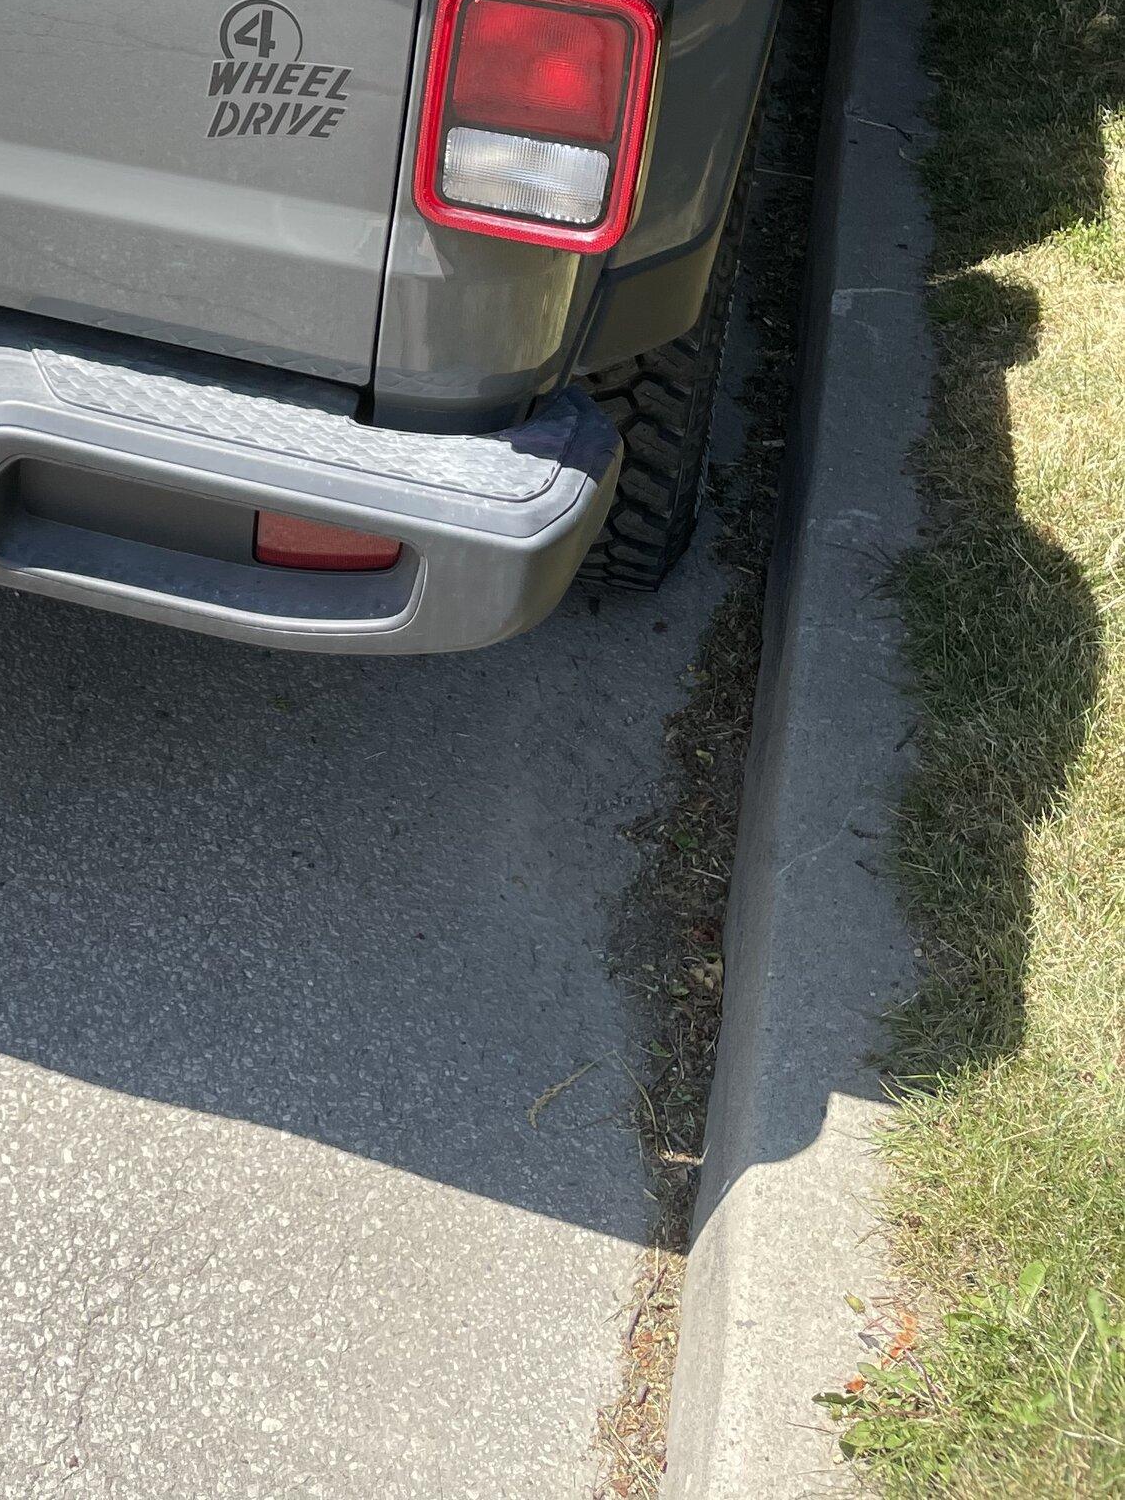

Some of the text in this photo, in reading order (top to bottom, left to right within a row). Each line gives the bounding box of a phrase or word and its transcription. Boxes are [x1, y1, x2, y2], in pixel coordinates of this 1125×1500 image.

[233, 9, 276, 59] 4
[207, 61, 353, 101] WHEEL
[206, 100, 346, 139] DRIVE
